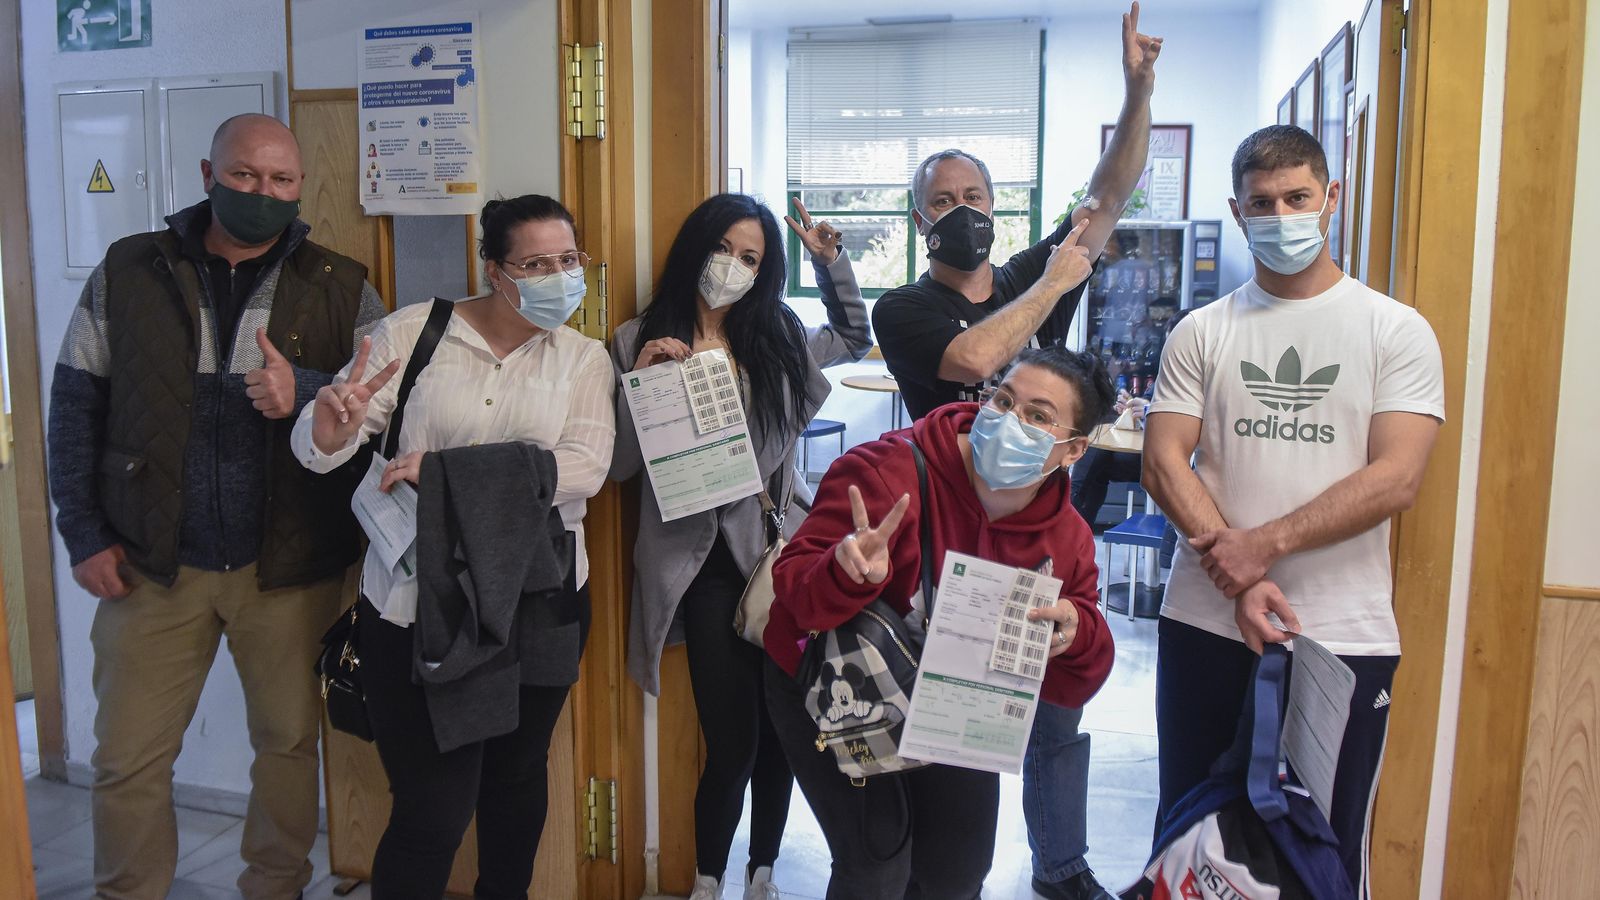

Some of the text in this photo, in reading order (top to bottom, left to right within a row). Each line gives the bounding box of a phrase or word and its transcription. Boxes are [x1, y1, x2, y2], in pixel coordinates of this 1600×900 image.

[364, 84, 376, 92] ¿Qué
[396, 97, 432, 105] respiratorios?
[1234, 414, 1335, 444] adidas
[1373, 692, 1392, 709] adidas
